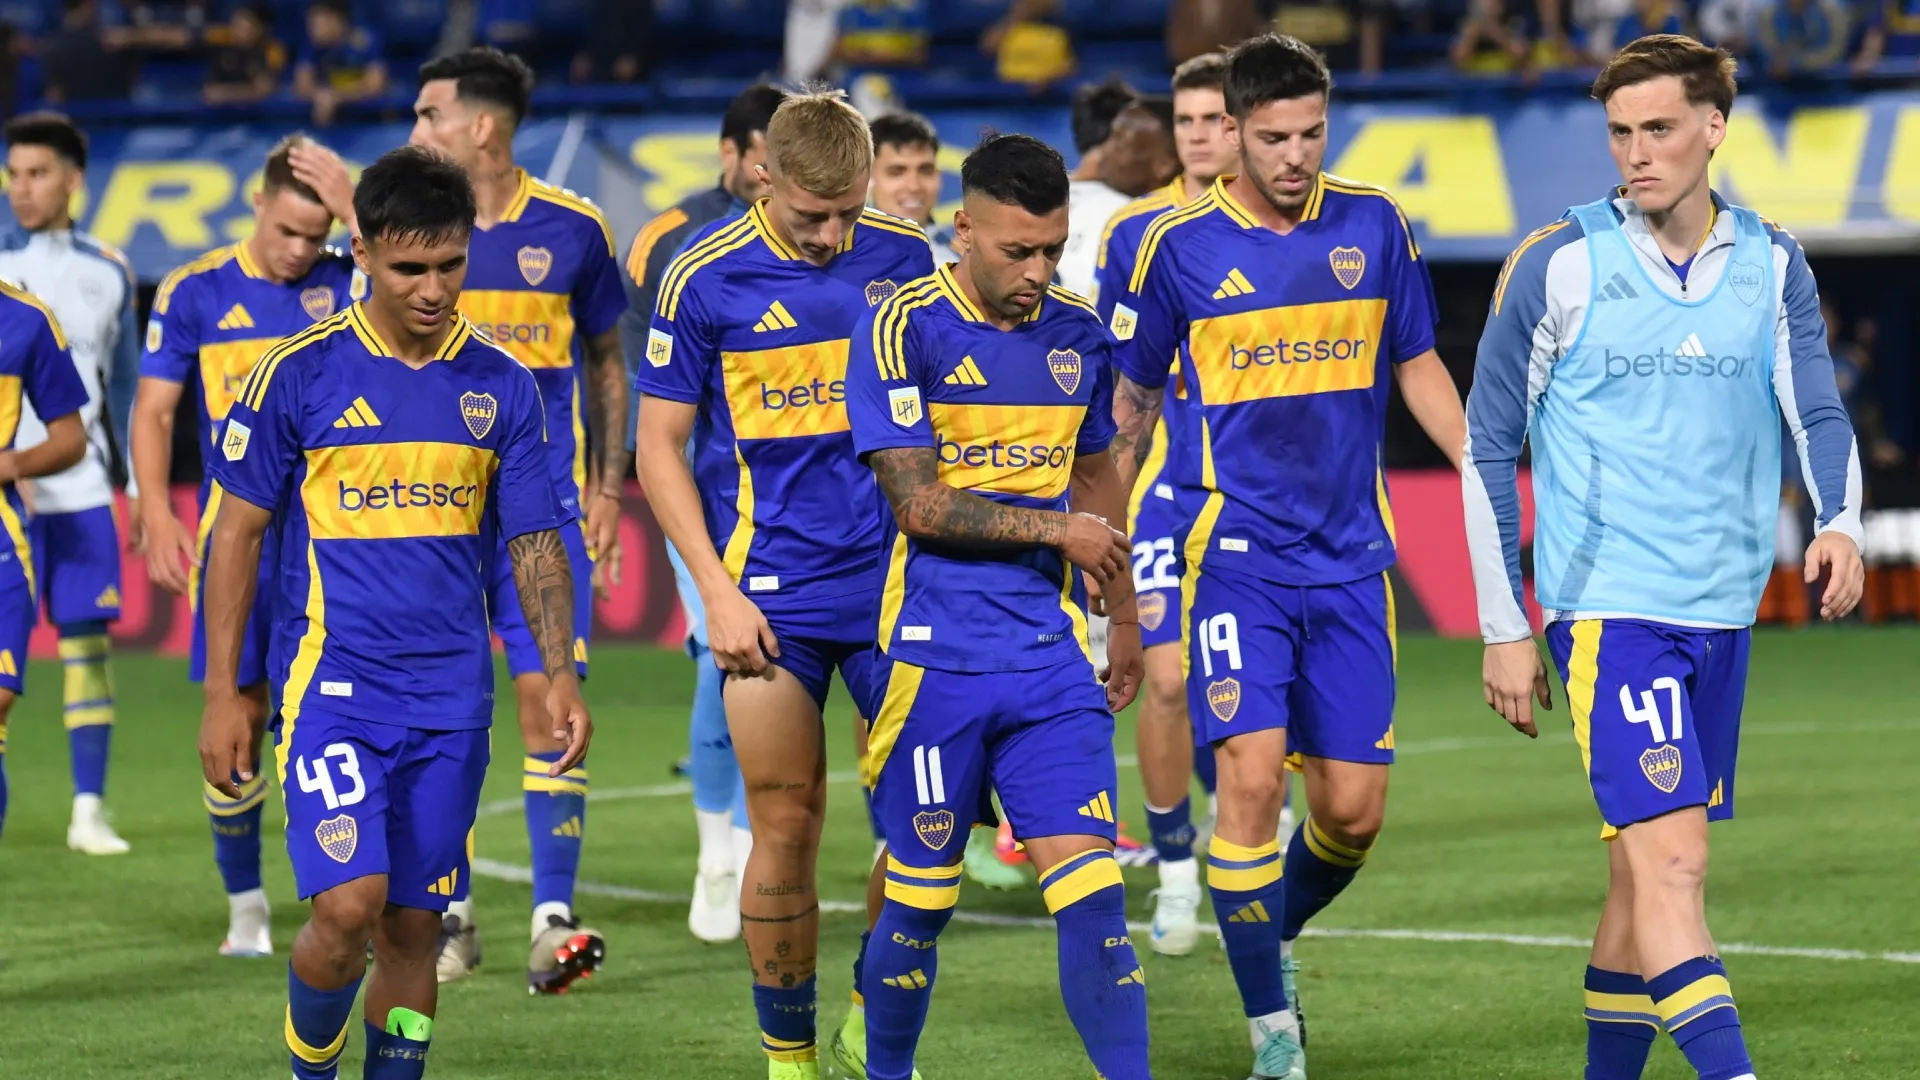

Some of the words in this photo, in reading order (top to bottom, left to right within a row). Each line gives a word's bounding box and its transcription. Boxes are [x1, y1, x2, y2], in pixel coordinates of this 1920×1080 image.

[1334, 261, 1361, 270] CABJ
[1732, 275, 1760, 285] CABJ
[1230, 338, 1366, 371] betsson
[1605, 347, 1754, 379] betsson
[1053, 363, 1078, 374] CABJ
[465, 406, 493, 418] CABJ
[1131, 536, 1180, 593] 22
[1199, 612, 1242, 677] 19
[1212, 691, 1237, 705] CABJ
[1619, 676, 1682, 743] 47
[913, 744, 946, 805] 11
[1647, 759, 1678, 775] CABJ
[296, 743, 366, 810] 43
[920, 821, 950, 833] CABJ
[322, 828, 353, 846] CABJ
[892, 932, 937, 949] CAB
